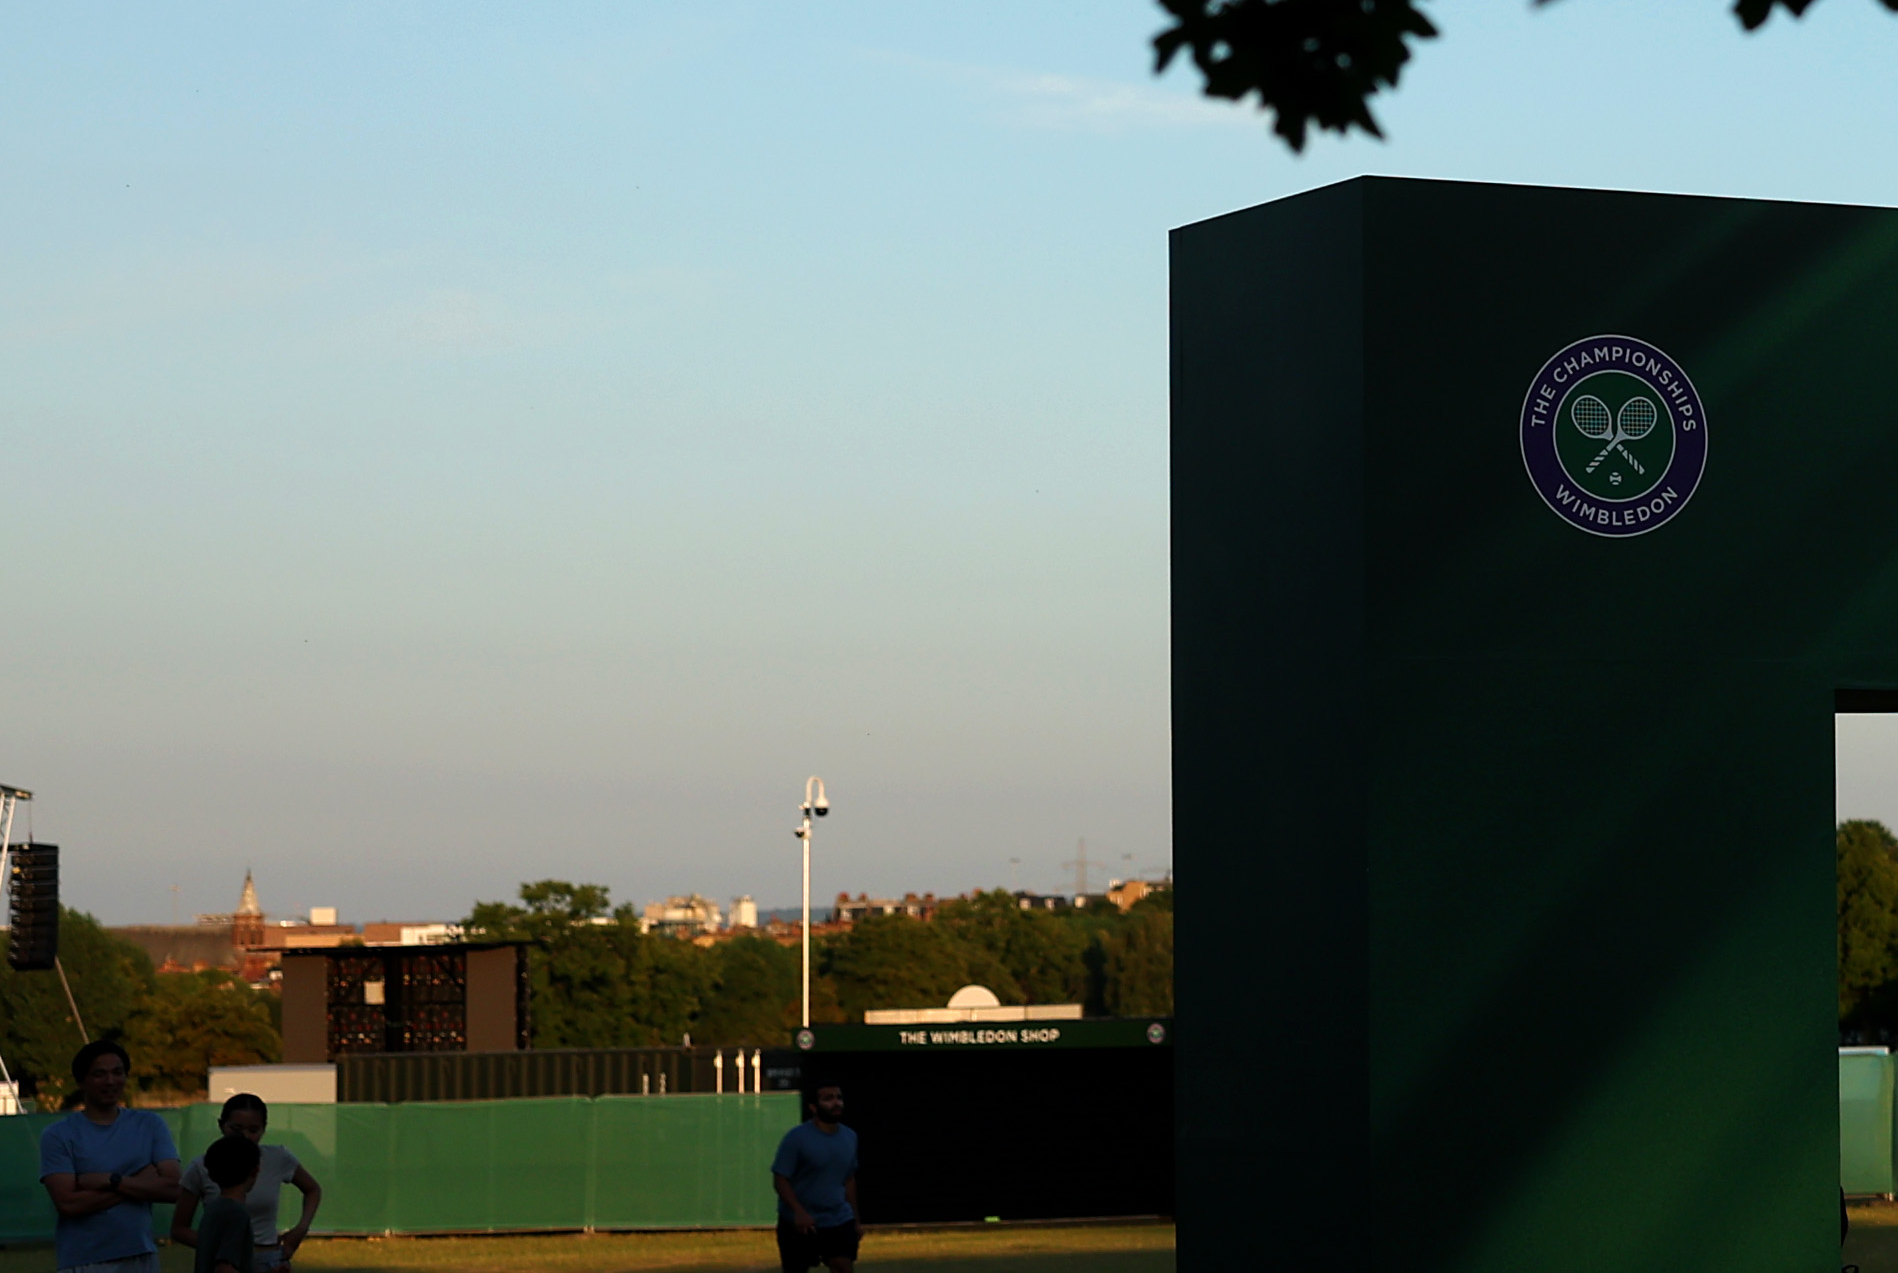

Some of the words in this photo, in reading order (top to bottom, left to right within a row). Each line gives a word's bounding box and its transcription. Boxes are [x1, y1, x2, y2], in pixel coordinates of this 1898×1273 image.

[1531, 383, 1556, 428] THE
[1553, 346, 1697, 432] CHAMPIONSHIPS
[1555, 483, 1679, 526] WIMBLEDON
[899, 1032, 927, 1045] THE
[930, 1030, 1018, 1044] WIMBLEDON
[1020, 1029, 1060, 1043] SHOP
